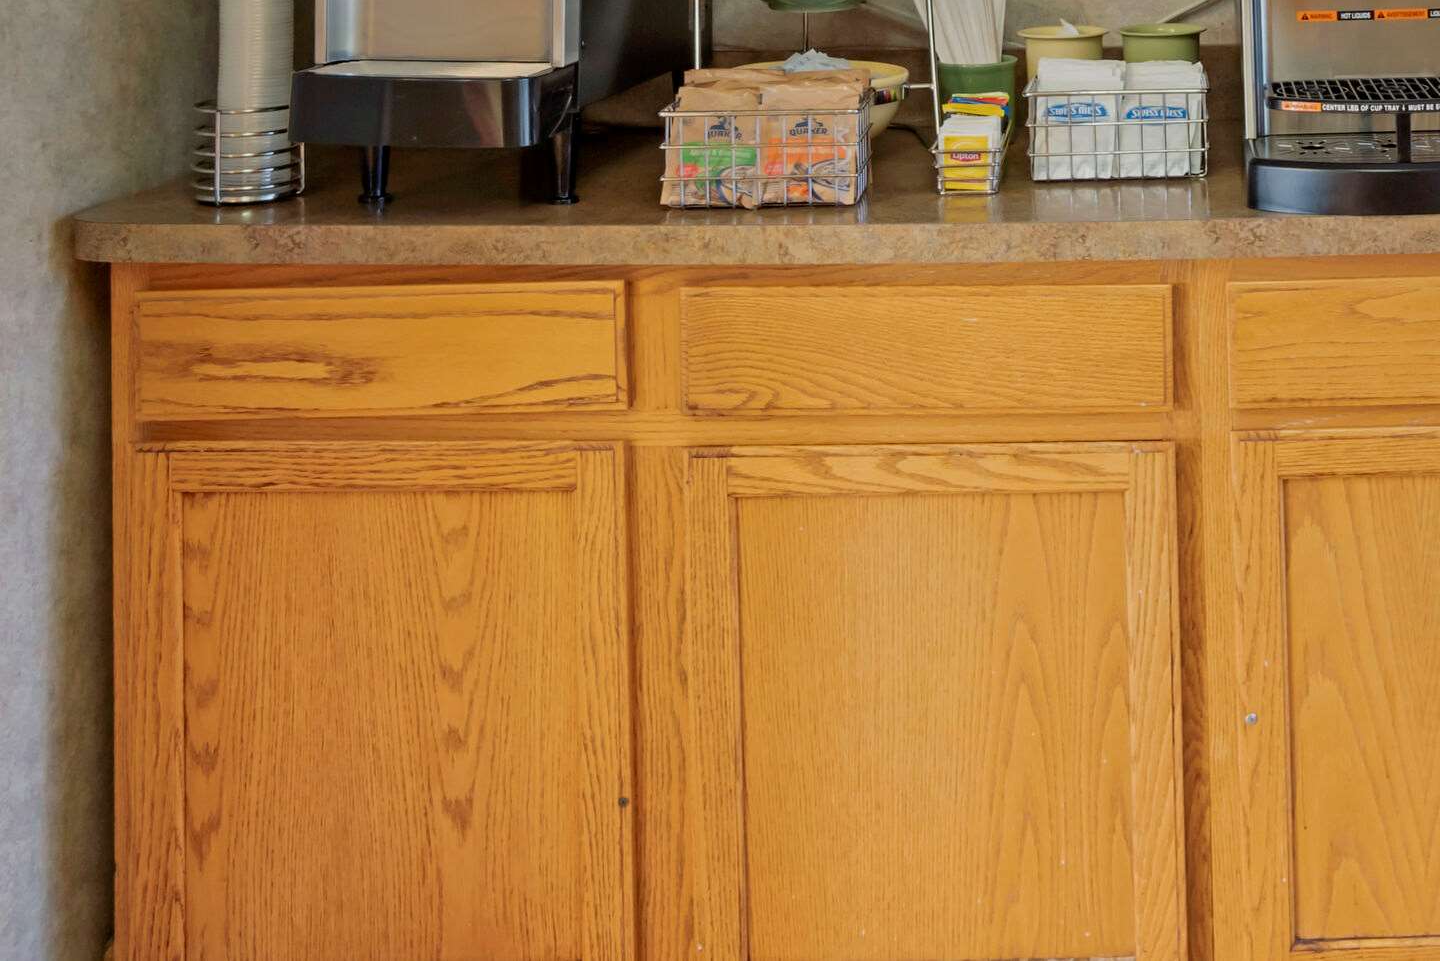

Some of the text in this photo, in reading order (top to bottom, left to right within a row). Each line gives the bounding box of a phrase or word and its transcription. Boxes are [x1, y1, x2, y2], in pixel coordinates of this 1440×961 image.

[1322, 103, 1344, 112] CENTER
[1360, 104, 1369, 112] OF
[1370, 104, 1383, 112] CUP
[1384, 103, 1399, 112] TRAY
[1408, 103, 1425, 111] MUST
[1425, 103, 1434, 111] BE
